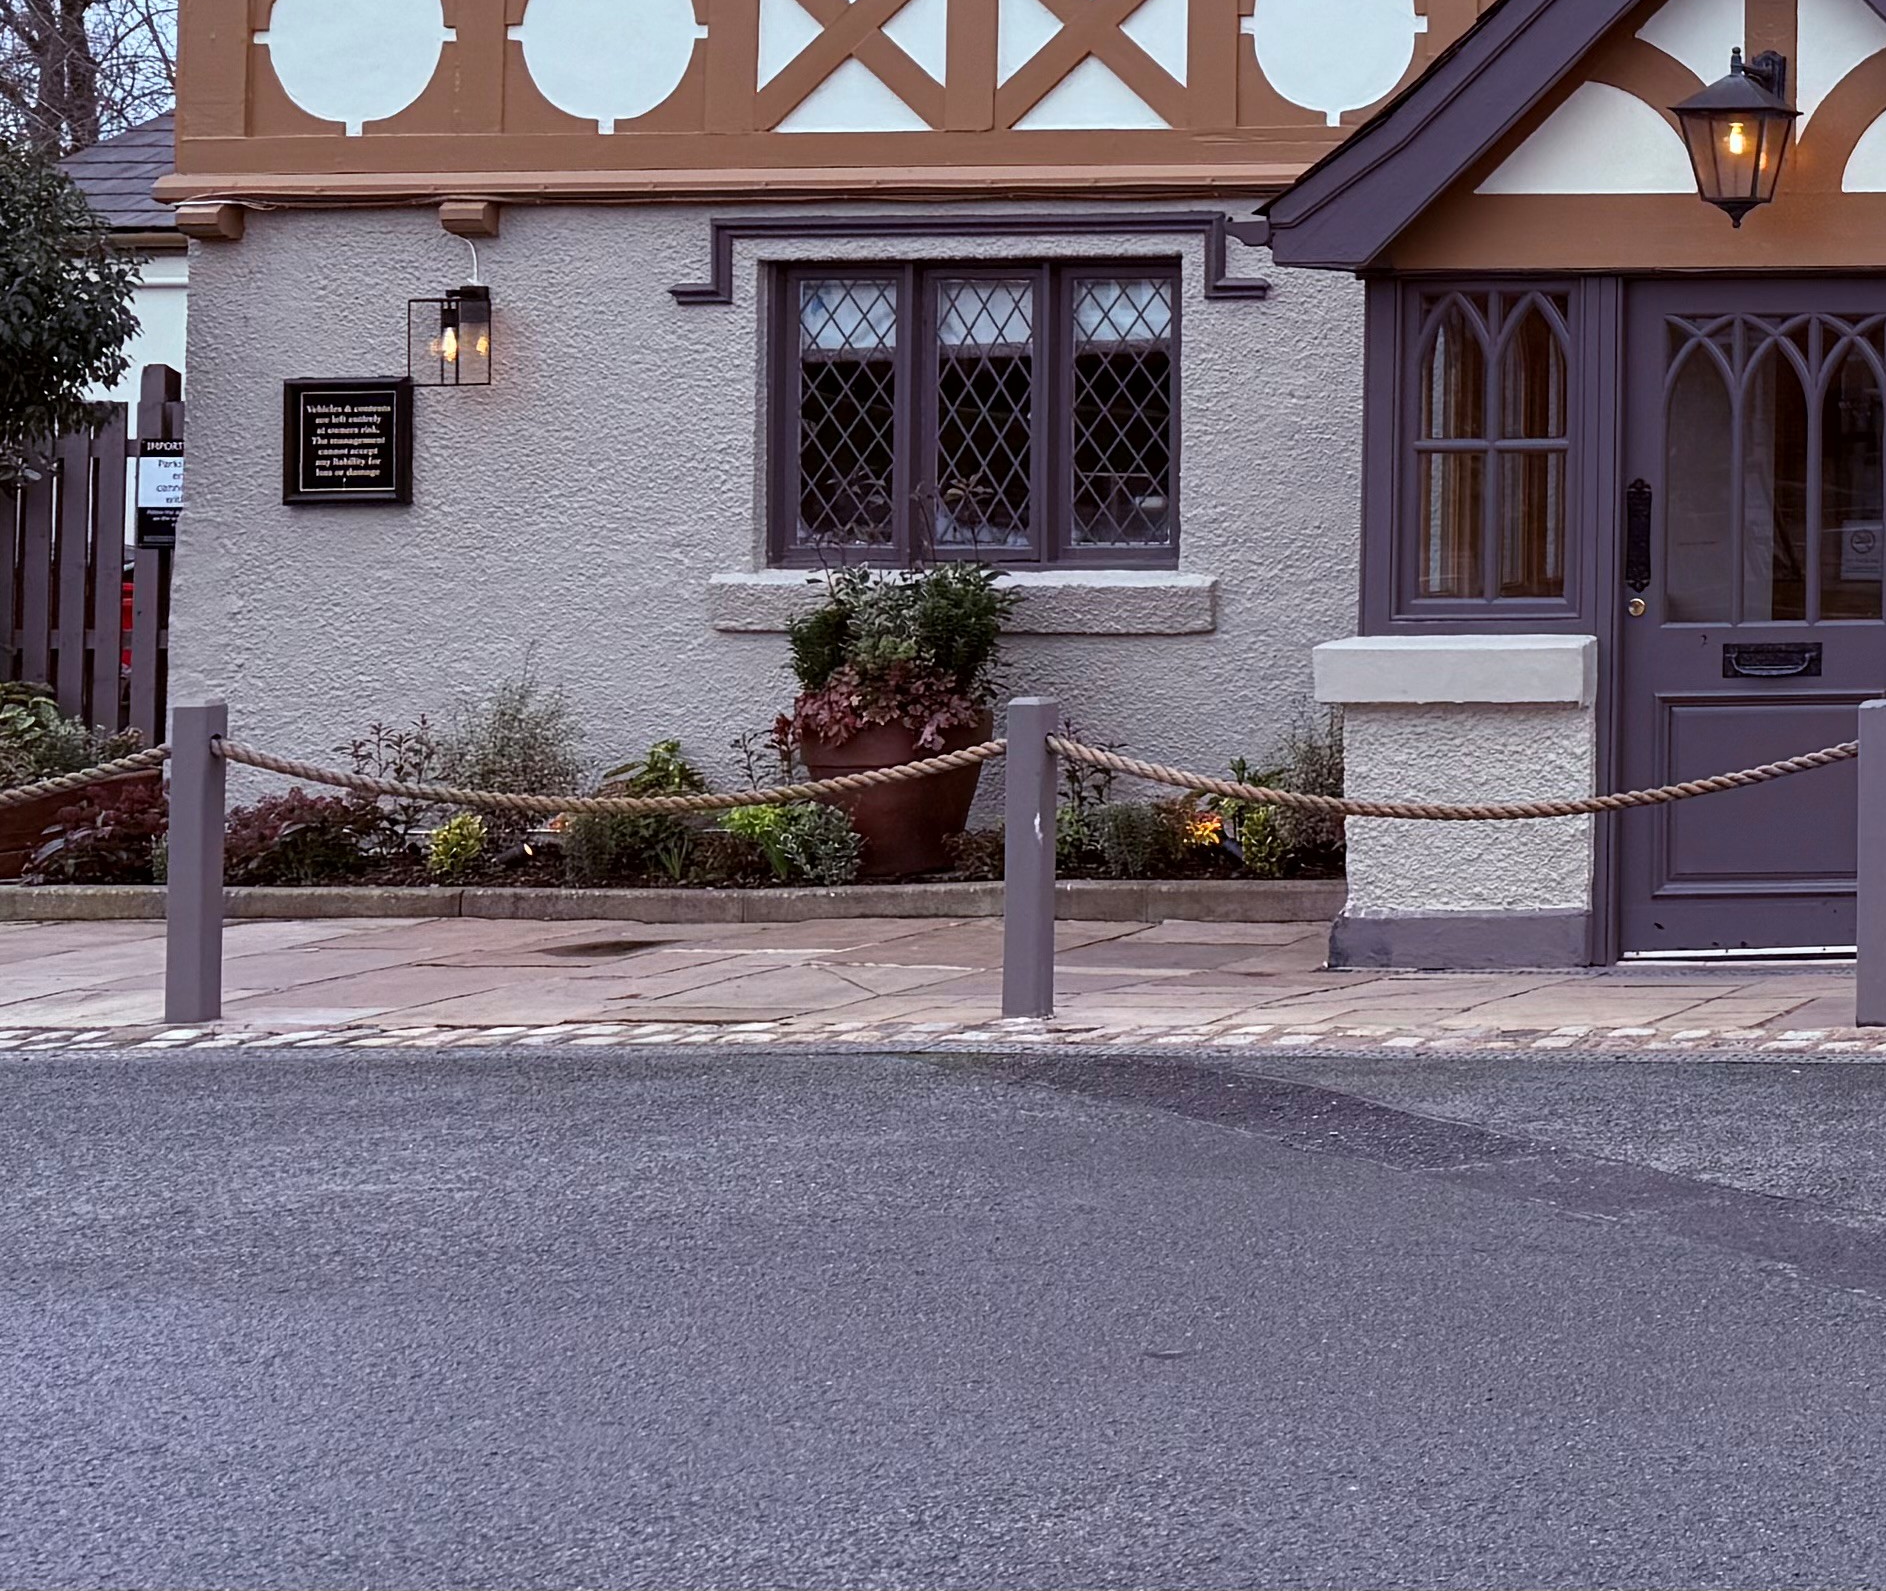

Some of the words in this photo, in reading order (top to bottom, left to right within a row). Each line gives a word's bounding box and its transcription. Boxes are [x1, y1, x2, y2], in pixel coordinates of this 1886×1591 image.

[306, 404, 342, 413] Vehicles
[344, 405, 352, 413] &
[332, 414, 346, 423] left
[147, 441, 184, 451] IMPORT
[312, 436, 328, 445] The
[330, 436, 385, 446] management
[346, 467, 380, 477] damage
